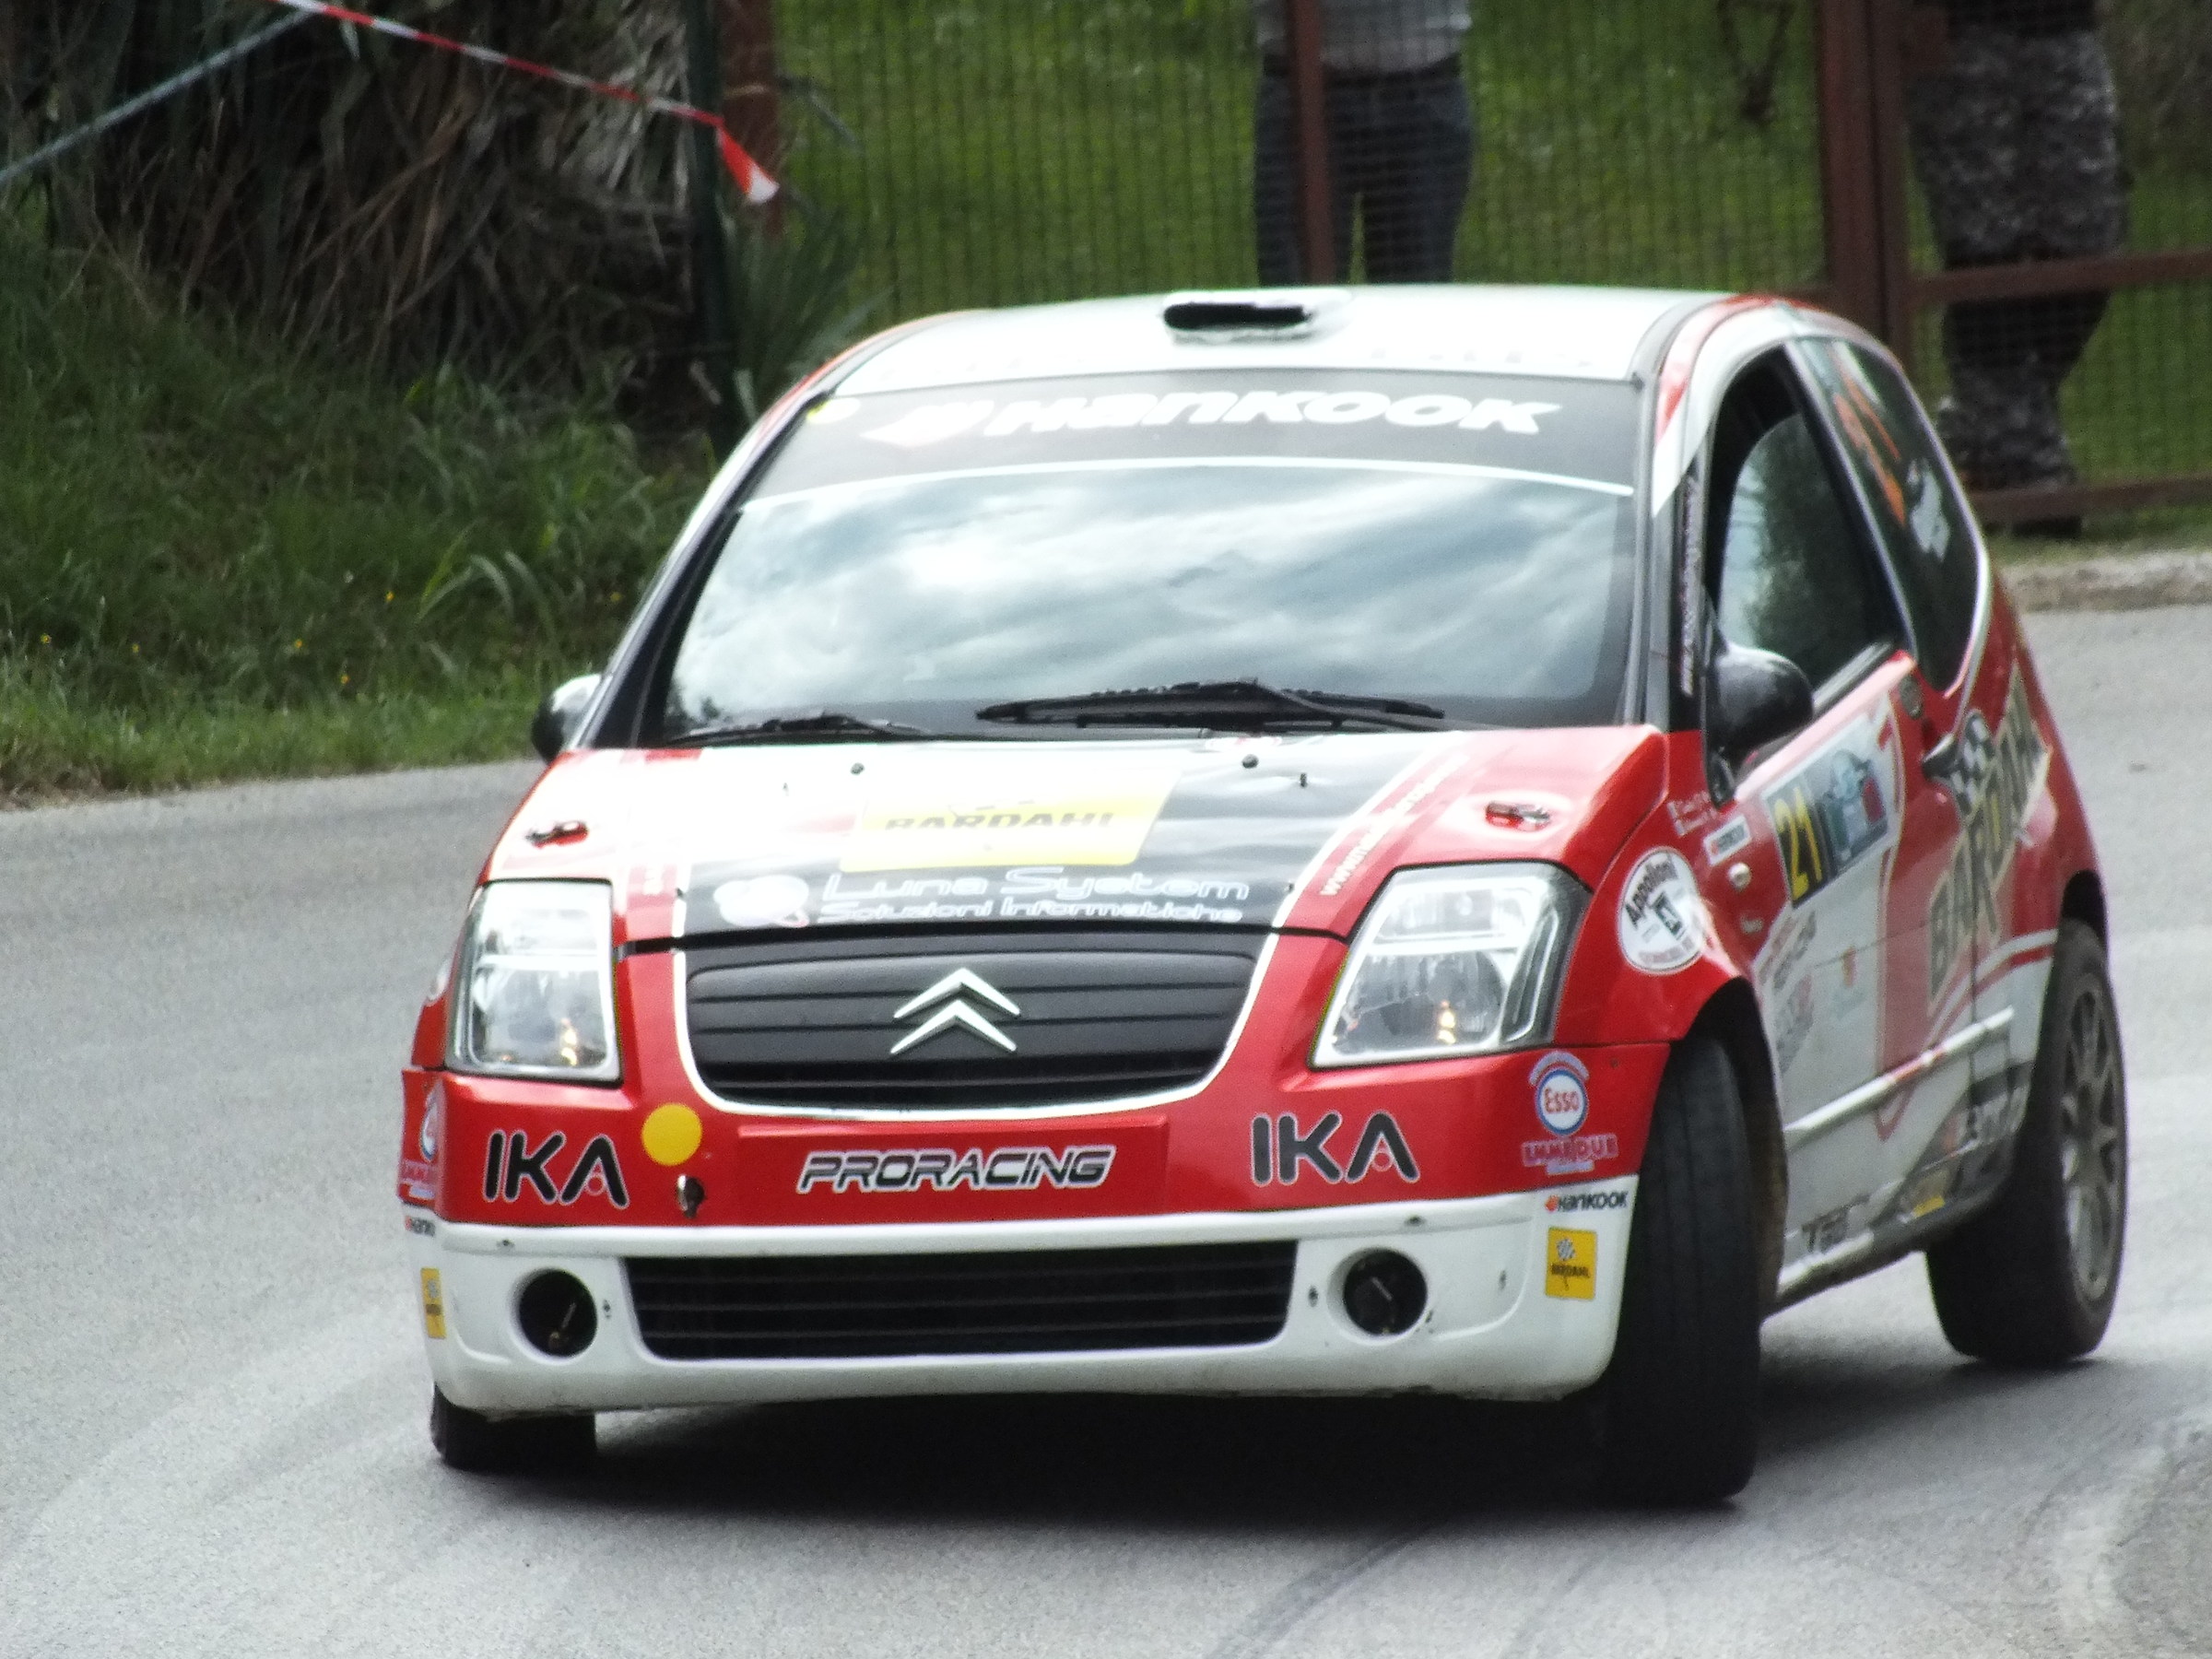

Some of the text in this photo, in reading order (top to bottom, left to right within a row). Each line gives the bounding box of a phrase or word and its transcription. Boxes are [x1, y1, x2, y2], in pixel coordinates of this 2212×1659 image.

[1773, 787, 1824, 900] 21
[822, 866, 1250, 901] Luna System
[483, 1129, 629, 1209] IKA
[796, 1145, 1117, 1195] PRORACING
[1251, 1111, 1420, 1187] IKA
